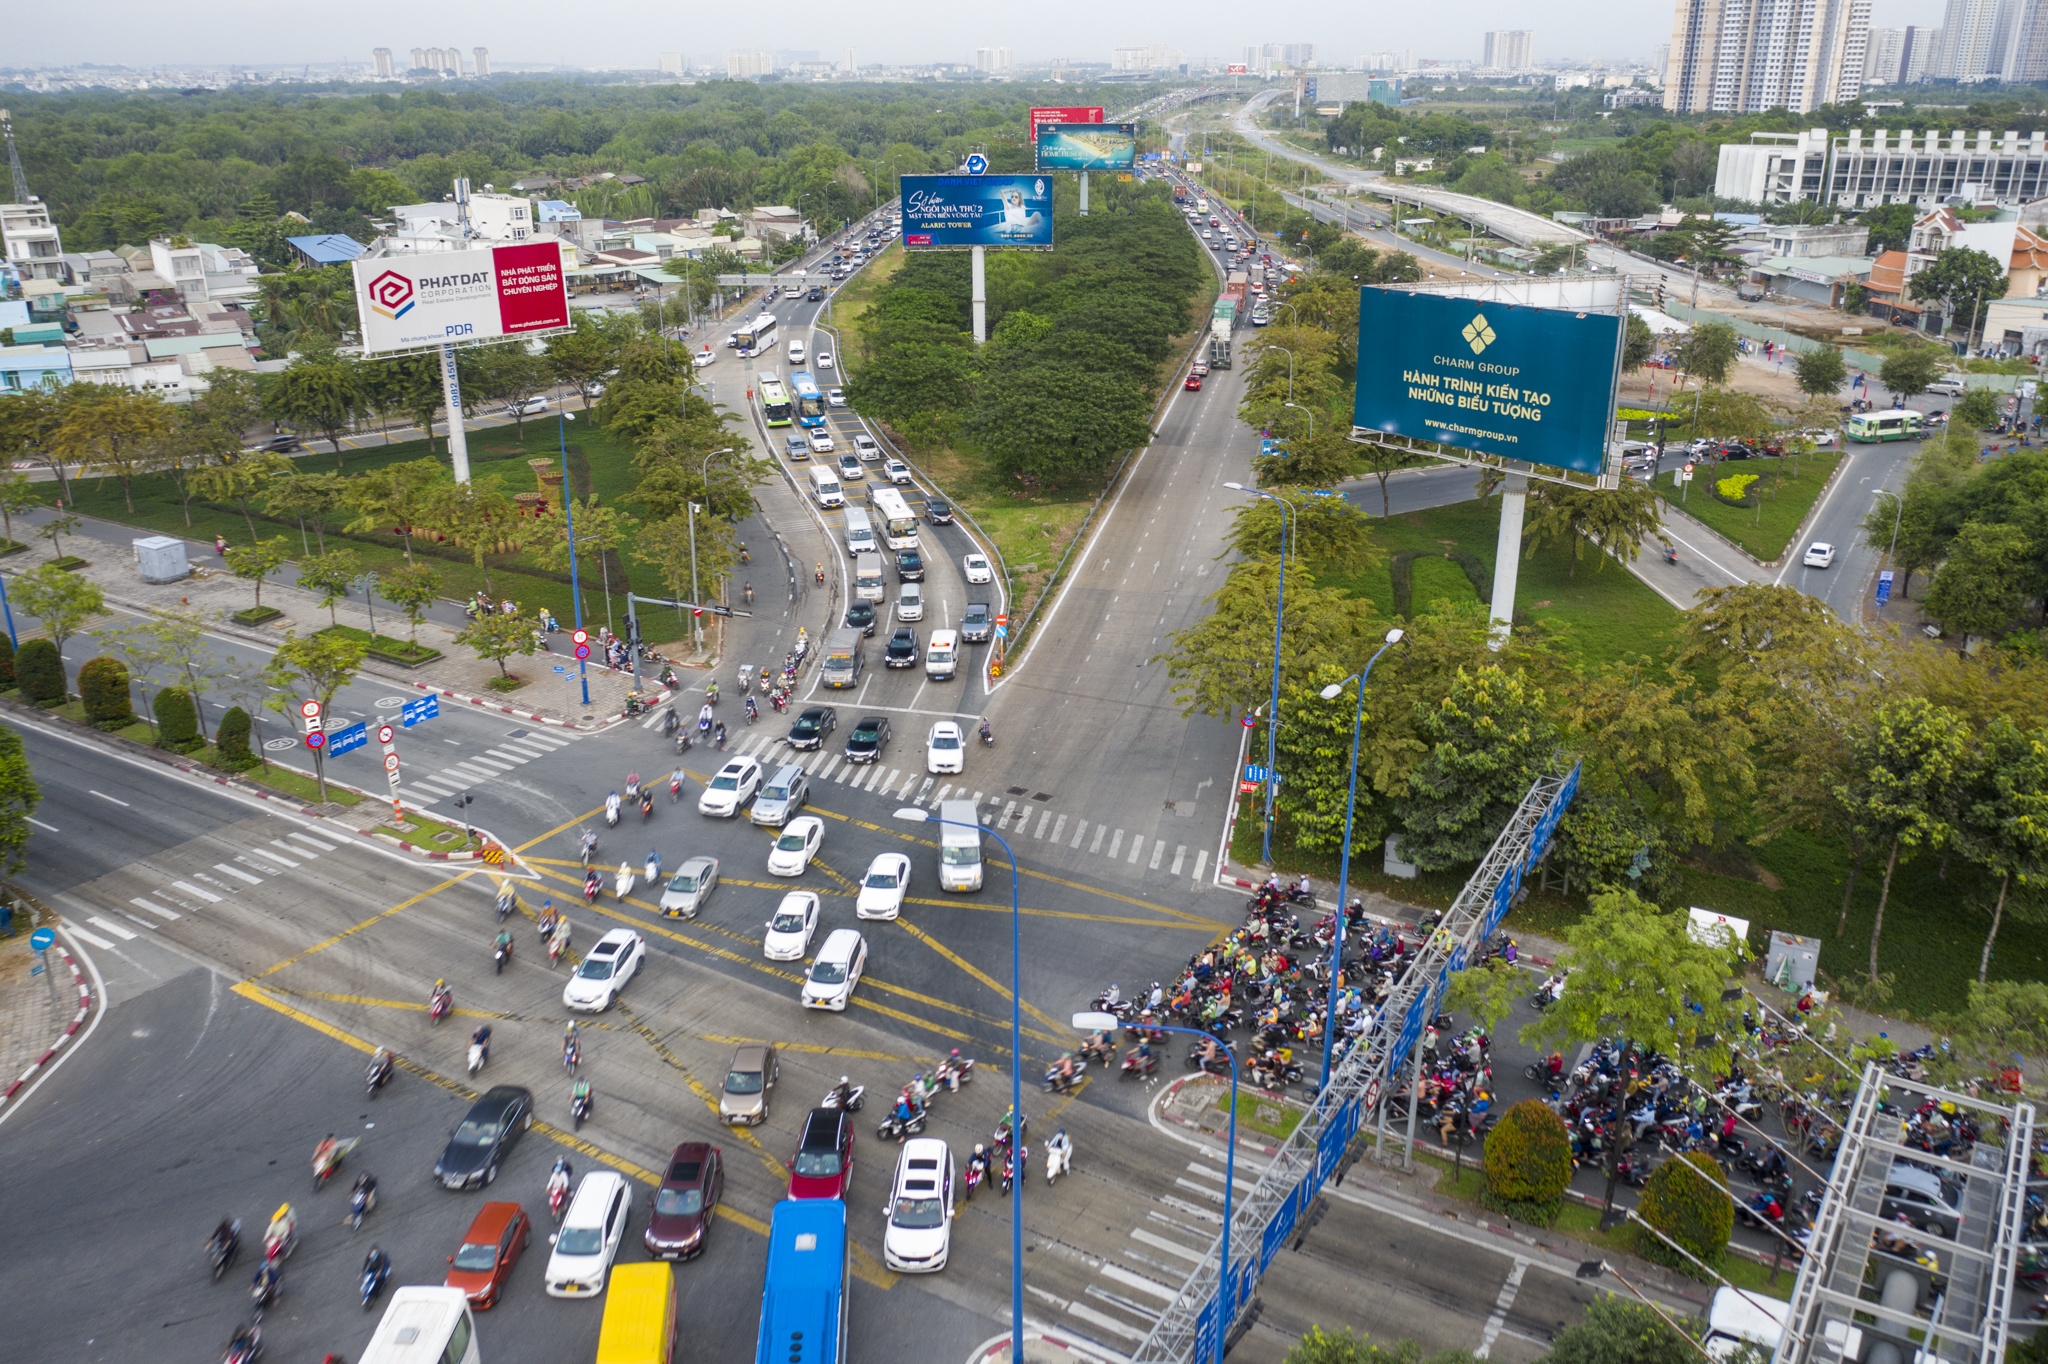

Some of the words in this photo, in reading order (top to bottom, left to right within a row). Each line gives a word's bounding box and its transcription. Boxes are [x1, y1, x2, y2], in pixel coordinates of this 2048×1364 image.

[921, 204, 940, 213] NGÔI
[941, 204, 958, 213] NHÀ
[501, 268, 516, 276] NHÀ
[517, 266, 535, 274] PHÁT
[419, 272, 488, 290] PHATDAT
[502, 277, 517, 286] BẤT
[518, 276, 540, 285] ĐỘNG
[421, 284, 491, 298] CORPORATION
[456, 293, 492, 301] Development
[503, 286, 532, 296] CHUYÊN
[446, 323, 473, 337] PDR
[510, 318, 560, 329] www.phatdat.com.vn
[446, 361, 456, 379] 456
[1433, 355, 1474, 370] CHARM
[1478, 362, 1520, 376] GROUP
[450, 382, 459, 407] 0982
[1403, 369, 1440, 387] HÀNH
[1443, 376, 1483, 394] TRÌNH
[1486, 383, 1519, 401] KIẾN
[1523, 390, 1551, 407] TẠO
[1408, 387, 1454, 406] NHỮNG
[1458, 395, 1489, 412] BIỂU
[1492, 402, 1542, 422] TƯỢNG
[1424, 418, 1518, 443] www.charmgroup.vn
